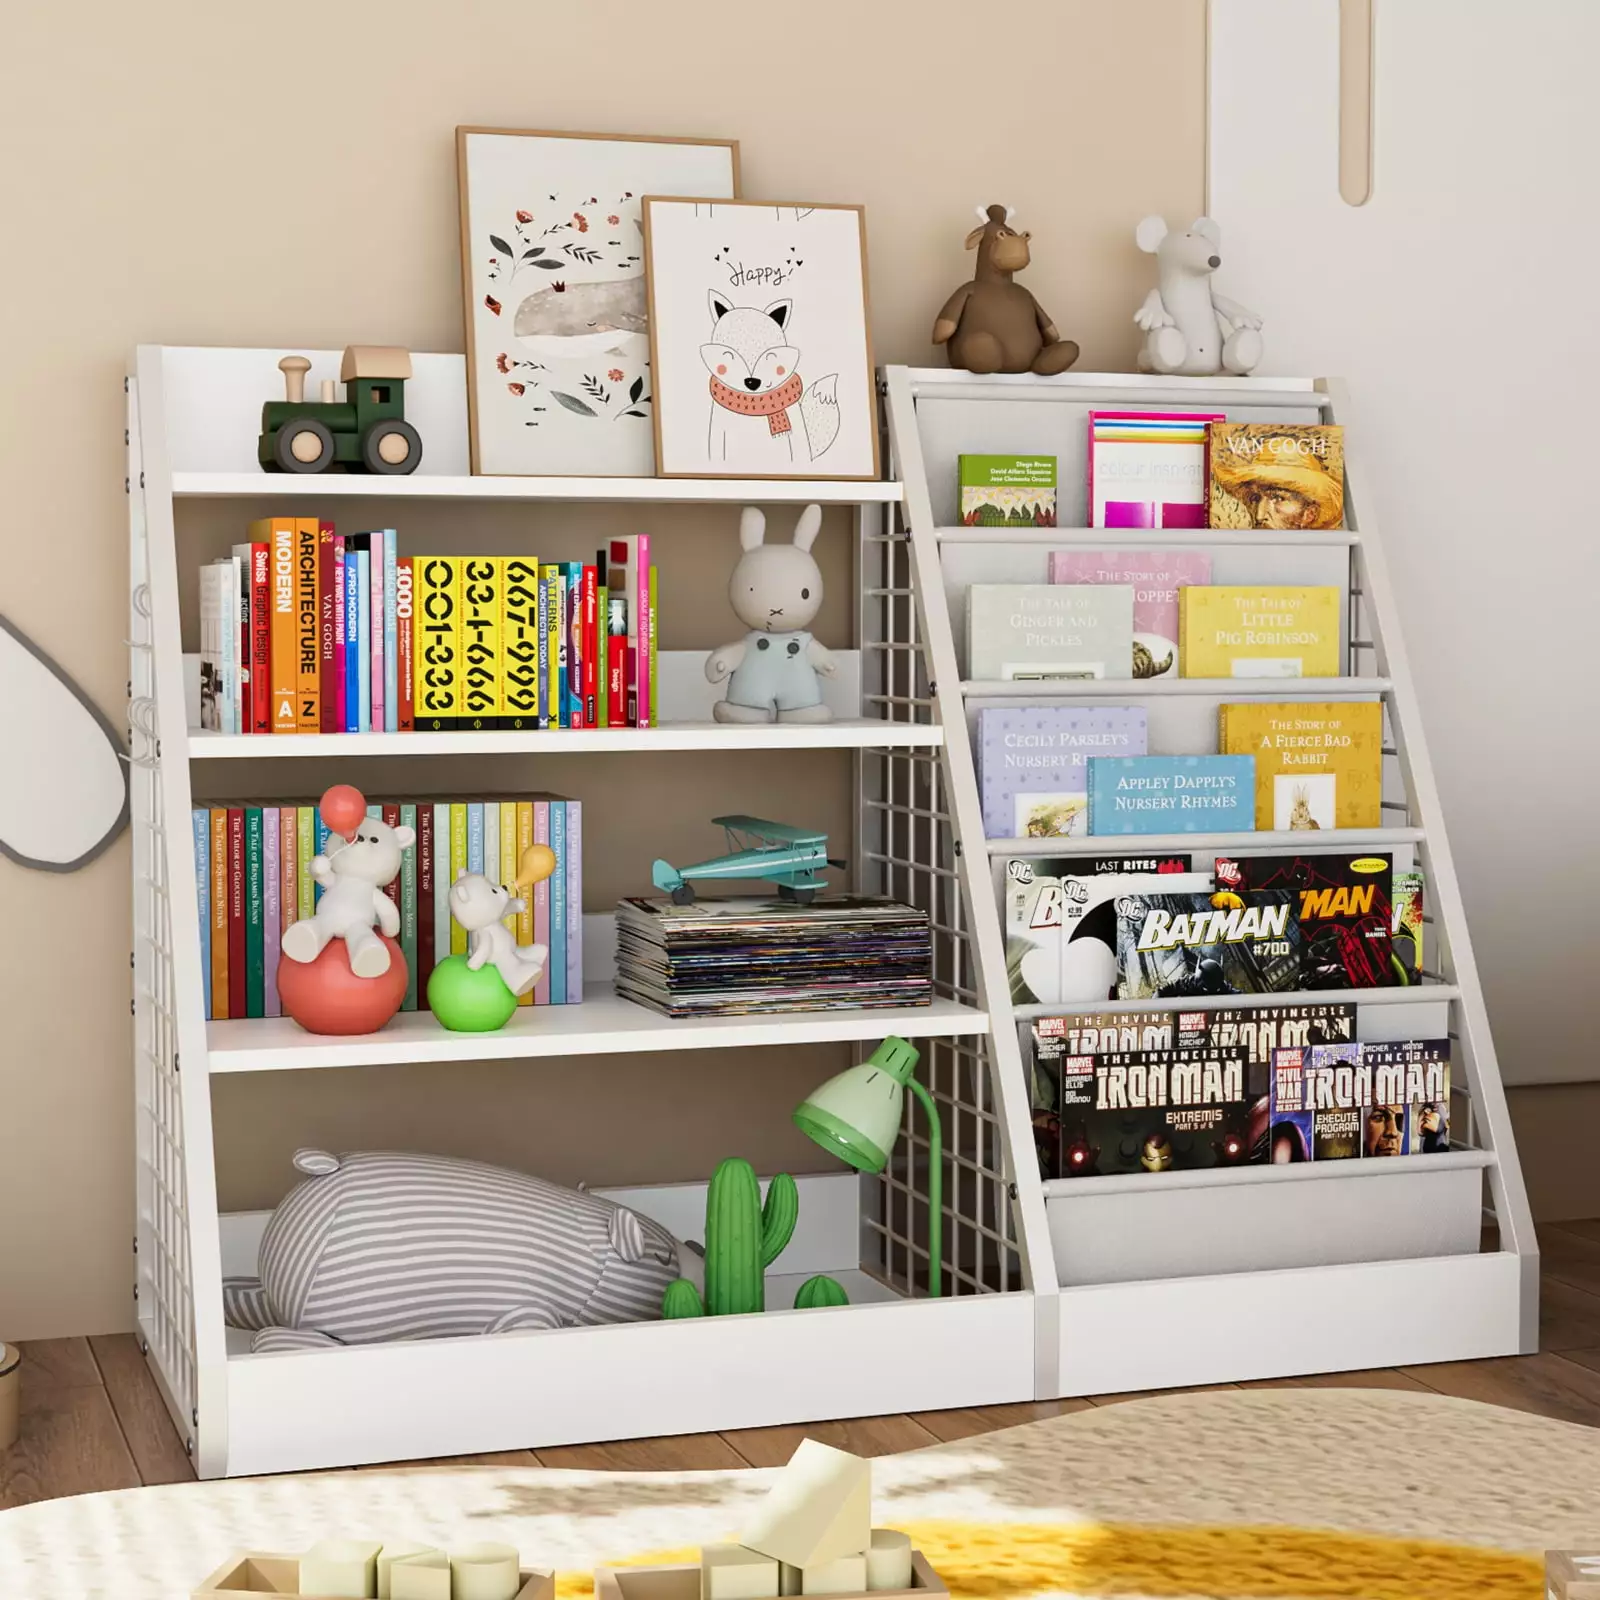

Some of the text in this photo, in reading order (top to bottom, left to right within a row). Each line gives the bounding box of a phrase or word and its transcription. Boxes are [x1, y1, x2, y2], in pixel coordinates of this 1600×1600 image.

[726, 261, 793, 287] Happy!
[1226, 436, 1326, 455] VAN GOGH
[1149, 460, 1202, 479] inspirat
[255, 551, 268, 583] Swiss
[276, 530, 293, 613] MODERN
[1097, 570, 1170, 582] THE STORY OF
[397, 565, 413, 618] 1000
[255, 586, 268, 626] Graphic
[300, 530, 315, 674] ARCHITECTURE
[347, 566, 357, 642] AFRO MODERN
[548, 569, 557, 633] PATTERNS
[1234, 598, 1304, 609] THE TALE OF
[323, 594, 332, 660] VAN GOGH
[539, 584, 547, 669] ARCHITECTS TODAY
[640, 589, 649, 656] colour inspiration
[1010, 613, 1097, 629] GINGER AND
[1242, 613, 1294, 627] LITTLE
[335, 624, 344, 645] PAINT
[425, 560, 453, 711] 001-333
[507, 560, 536, 711] 667-999
[1026, 633, 1083, 646] PICKLES
[1216, 630, 1319, 645] PIG ROBINSON
[255, 629, 268, 665] Design
[611, 668, 620, 692] Design
[278, 700, 294, 718] A
[302, 700, 315, 717] Z
[1269, 719, 1342, 730] THE STORY OF
[1004, 732, 1129, 748] CECILY PARSLEY'S
[1260, 734, 1351, 748] A FIERCE BAD
[1004, 753, 1069, 768] NURSERY
[1282, 752, 1329, 765] RABBIT
[1116, 775, 1236, 790] APPLEY DAPPLY'S
[1115, 795, 1238, 811] NURSERY RHYMES
[423, 847, 430, 857] OF
[234, 860, 241, 870] OF
[250, 816, 258, 925] THE TALE OF BENJAMIN BUNNY
[1095, 860, 1158, 872] LAST RITES
[1300, 884, 1375, 922] MAN
[1136, 903, 1290, 953] BATMAN
[1252, 941, 1290, 957] #700
[1252, 1006, 1345, 1019] INVINCIBLE
[1039, 1018, 1065, 1030] MARVEL
[1075, 1016, 1102, 1027] THE
[1066, 1056, 1094, 1068] MARVEL
[1102, 1048, 1238, 1065] THE INVINCIBLE
[1276, 1068, 1302, 1082] CIVIL
[1065, 1081, 1084, 1090] ELLIS
[1096, 1060, 1243, 1110] IRON MAN
[1277, 1081, 1302, 1100] WAR
[1304, 1062, 1444, 1111] IRON MAN
[1165, 1109, 1224, 1124] EXTREMIS
[1316, 1112, 1359, 1124] EXECUTE
[1315, 1122, 1360, 1135] PROGRAM
